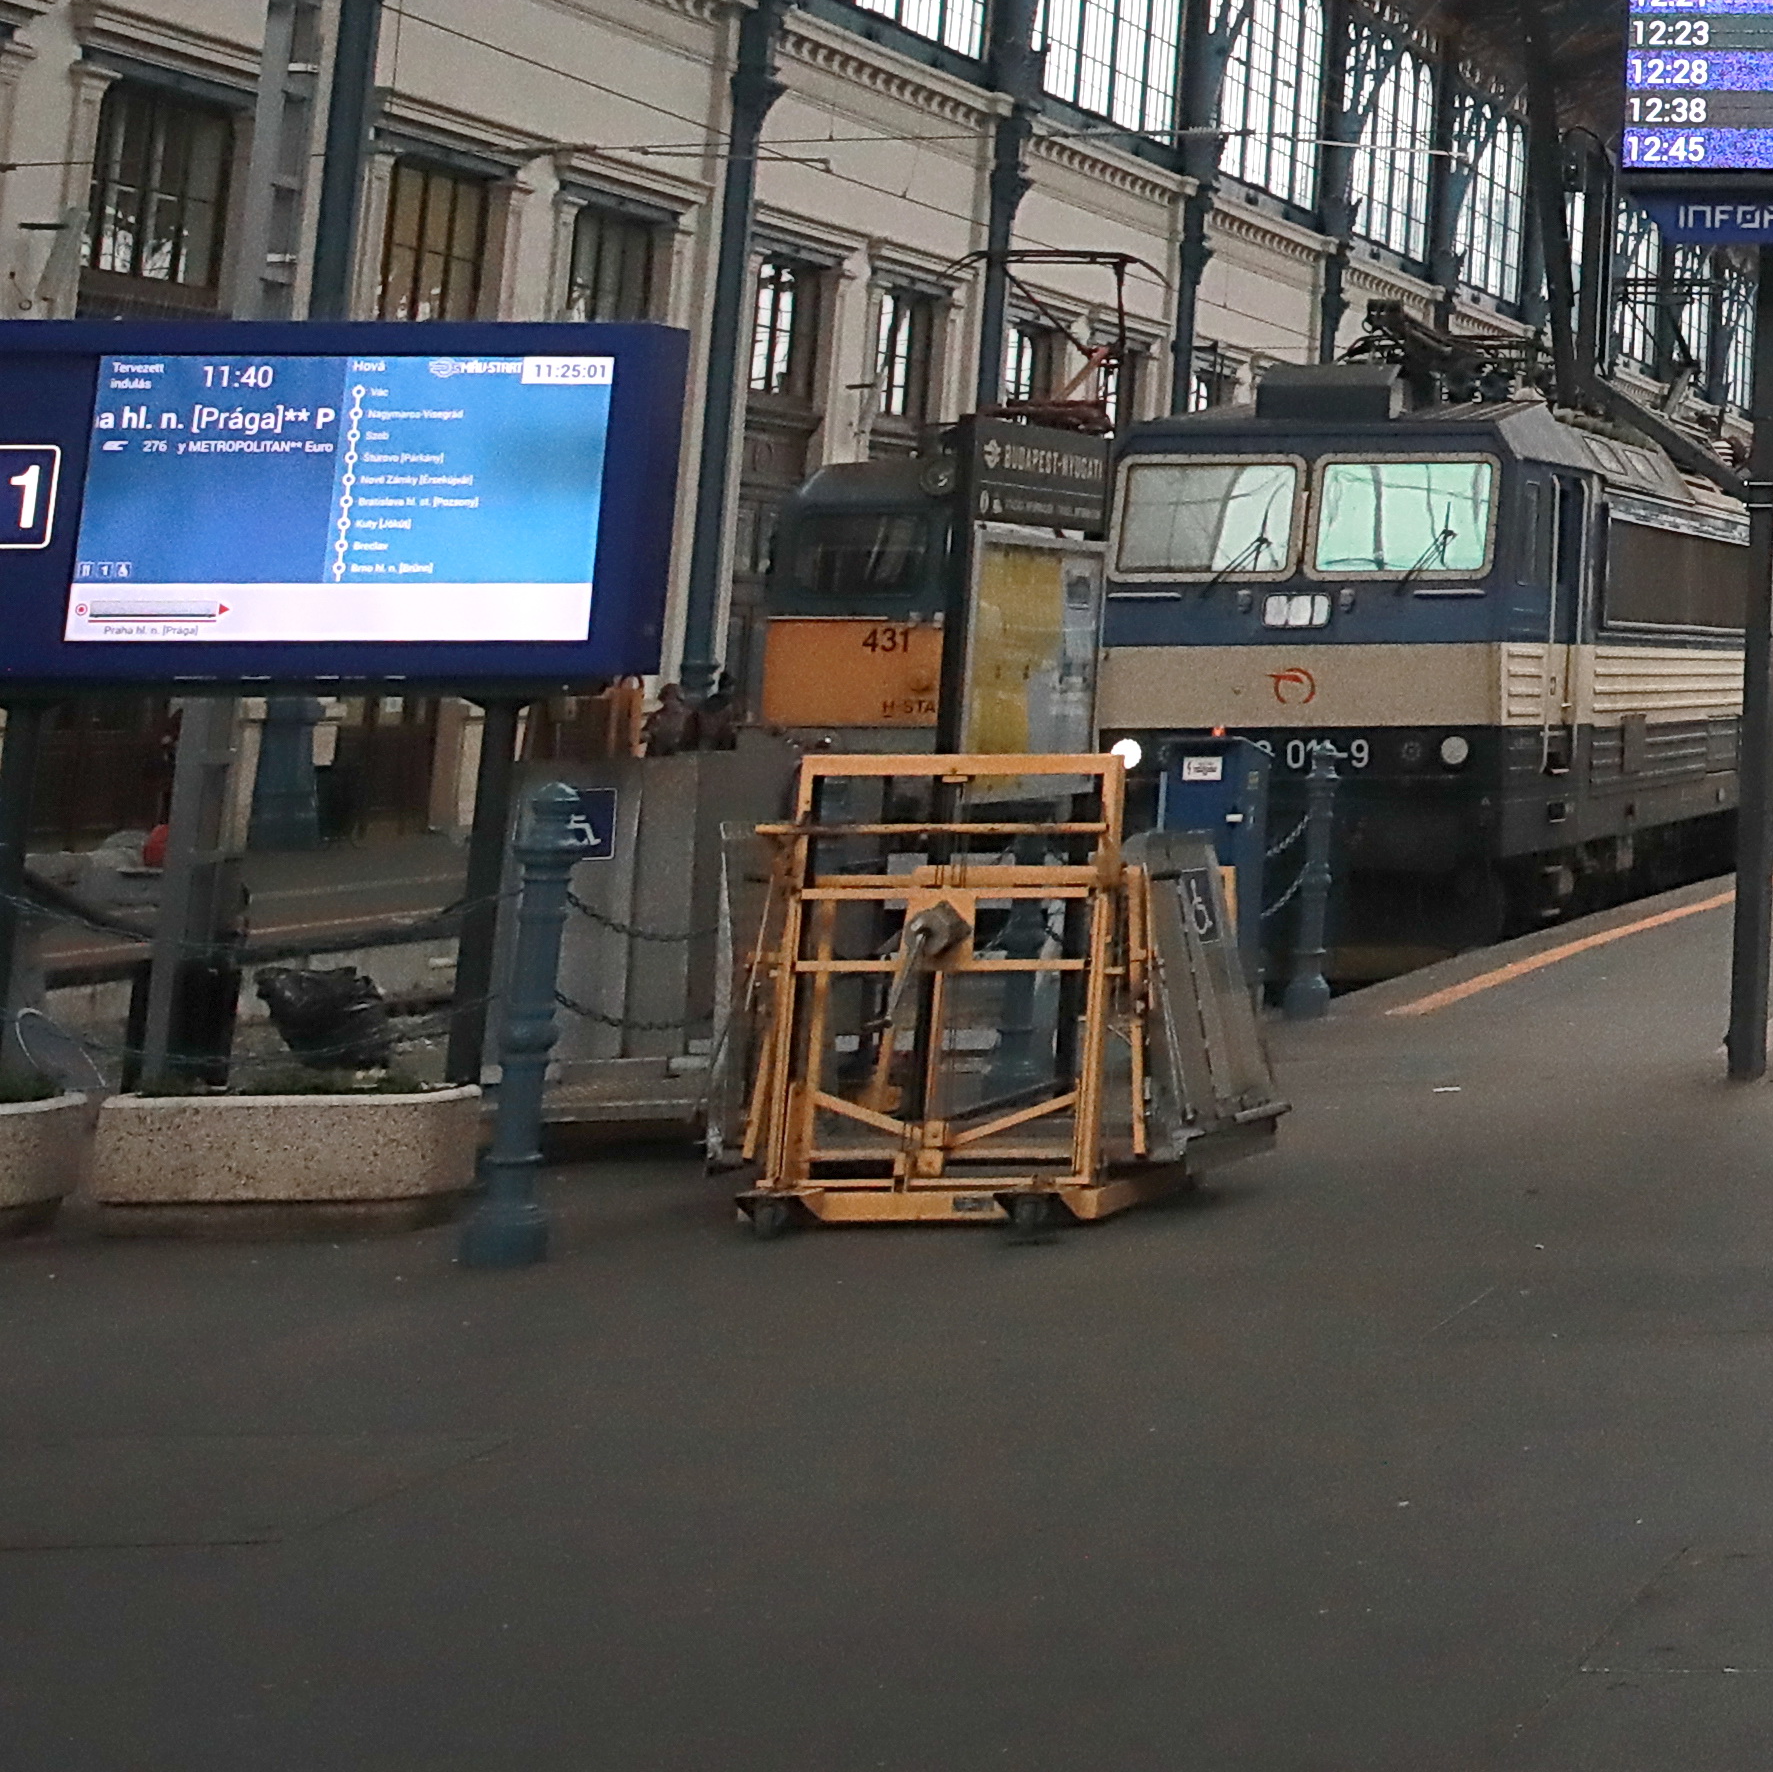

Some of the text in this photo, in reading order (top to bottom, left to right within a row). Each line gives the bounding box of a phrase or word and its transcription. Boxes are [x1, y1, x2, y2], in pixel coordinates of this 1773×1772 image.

[1633, 21, 1709, 46] 12:23
[1627, 137, 1706, 162] 12:45
[110, 378, 151, 389] indulás
[113, 362, 164, 374] Tervezett
[204, 366, 273, 388] 11:40
[353, 360, 385, 372] Hová
[535, 364, 606, 378] 11:25:01
[122, 406, 152, 429] hl.
[161, 412, 184, 429] n.
[143, 441, 167, 452] 276
[305, 441, 334, 452] Euro
[10, 464, 40, 528] 1
[862, 628, 909, 653] 431
